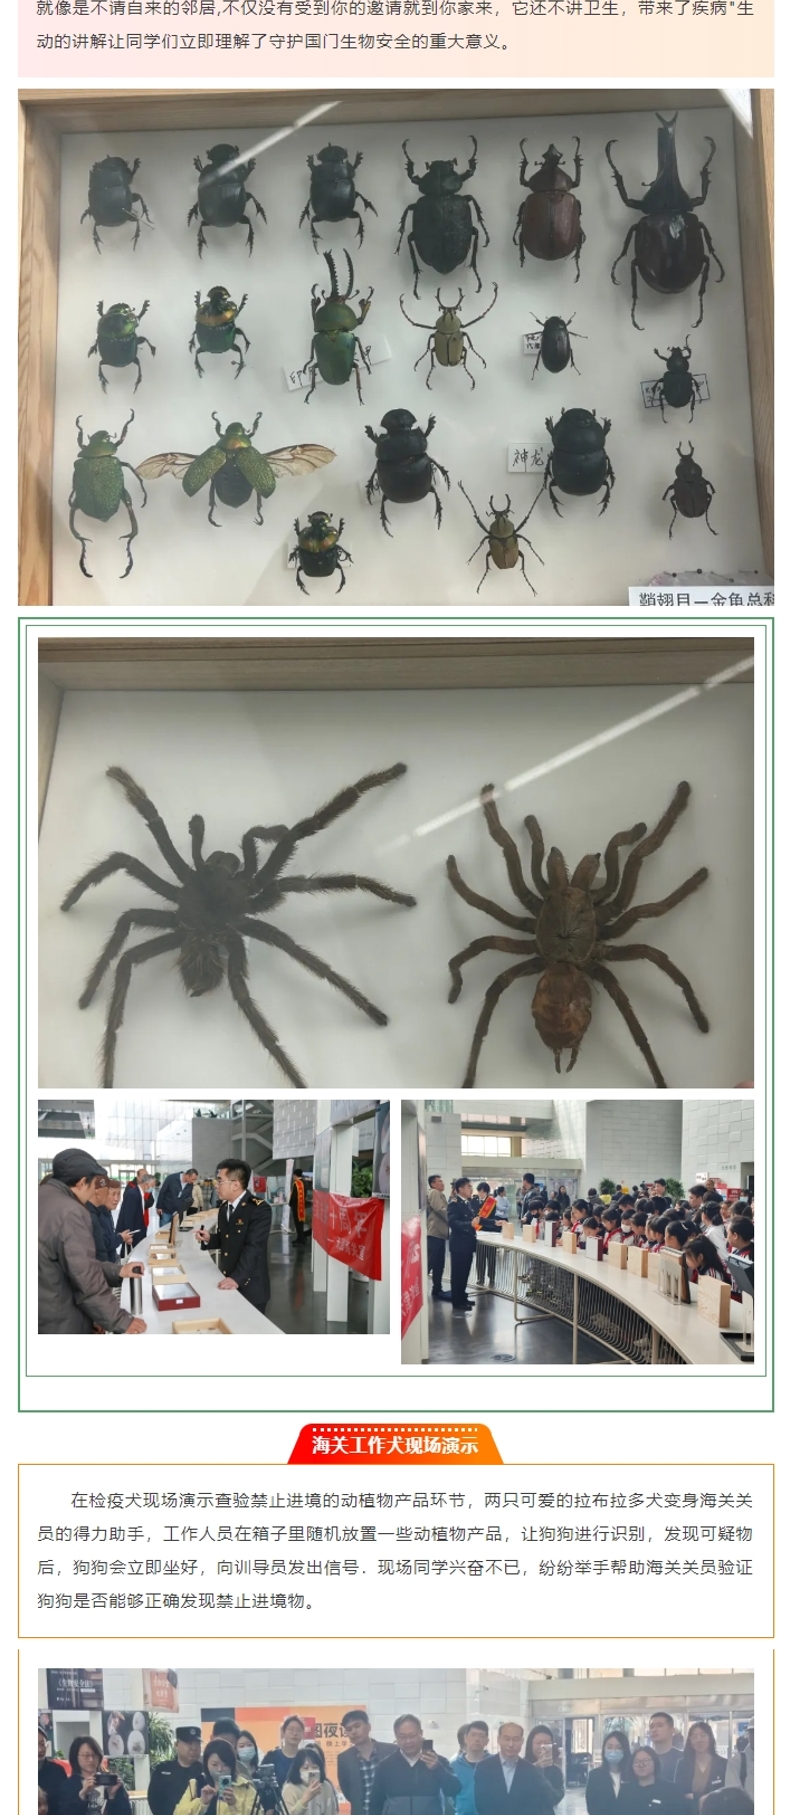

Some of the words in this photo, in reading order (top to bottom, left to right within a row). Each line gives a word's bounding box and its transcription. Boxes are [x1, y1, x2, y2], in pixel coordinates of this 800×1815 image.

[36, 33, 508, 51] 动的讲解让同学们立即理解了守护国门生物安全的重大意义。
[312, 1435, 479, 1455] 海关工作犬现场演示
[71, 1491, 753, 1510] 在检疫犬现场演示查验禁止进境的动植物产品环节，两只可爱的拉布拉多犬变身海关关
[37, 1525, 753, 1543] 员的得力助手，工作人员在箱子里随机放置一些动植物产品，让狗狗进行识别，发现可疑物
[37, 1592, 313, 1610] 狗狗是否能够正确发现禁止进境物。
